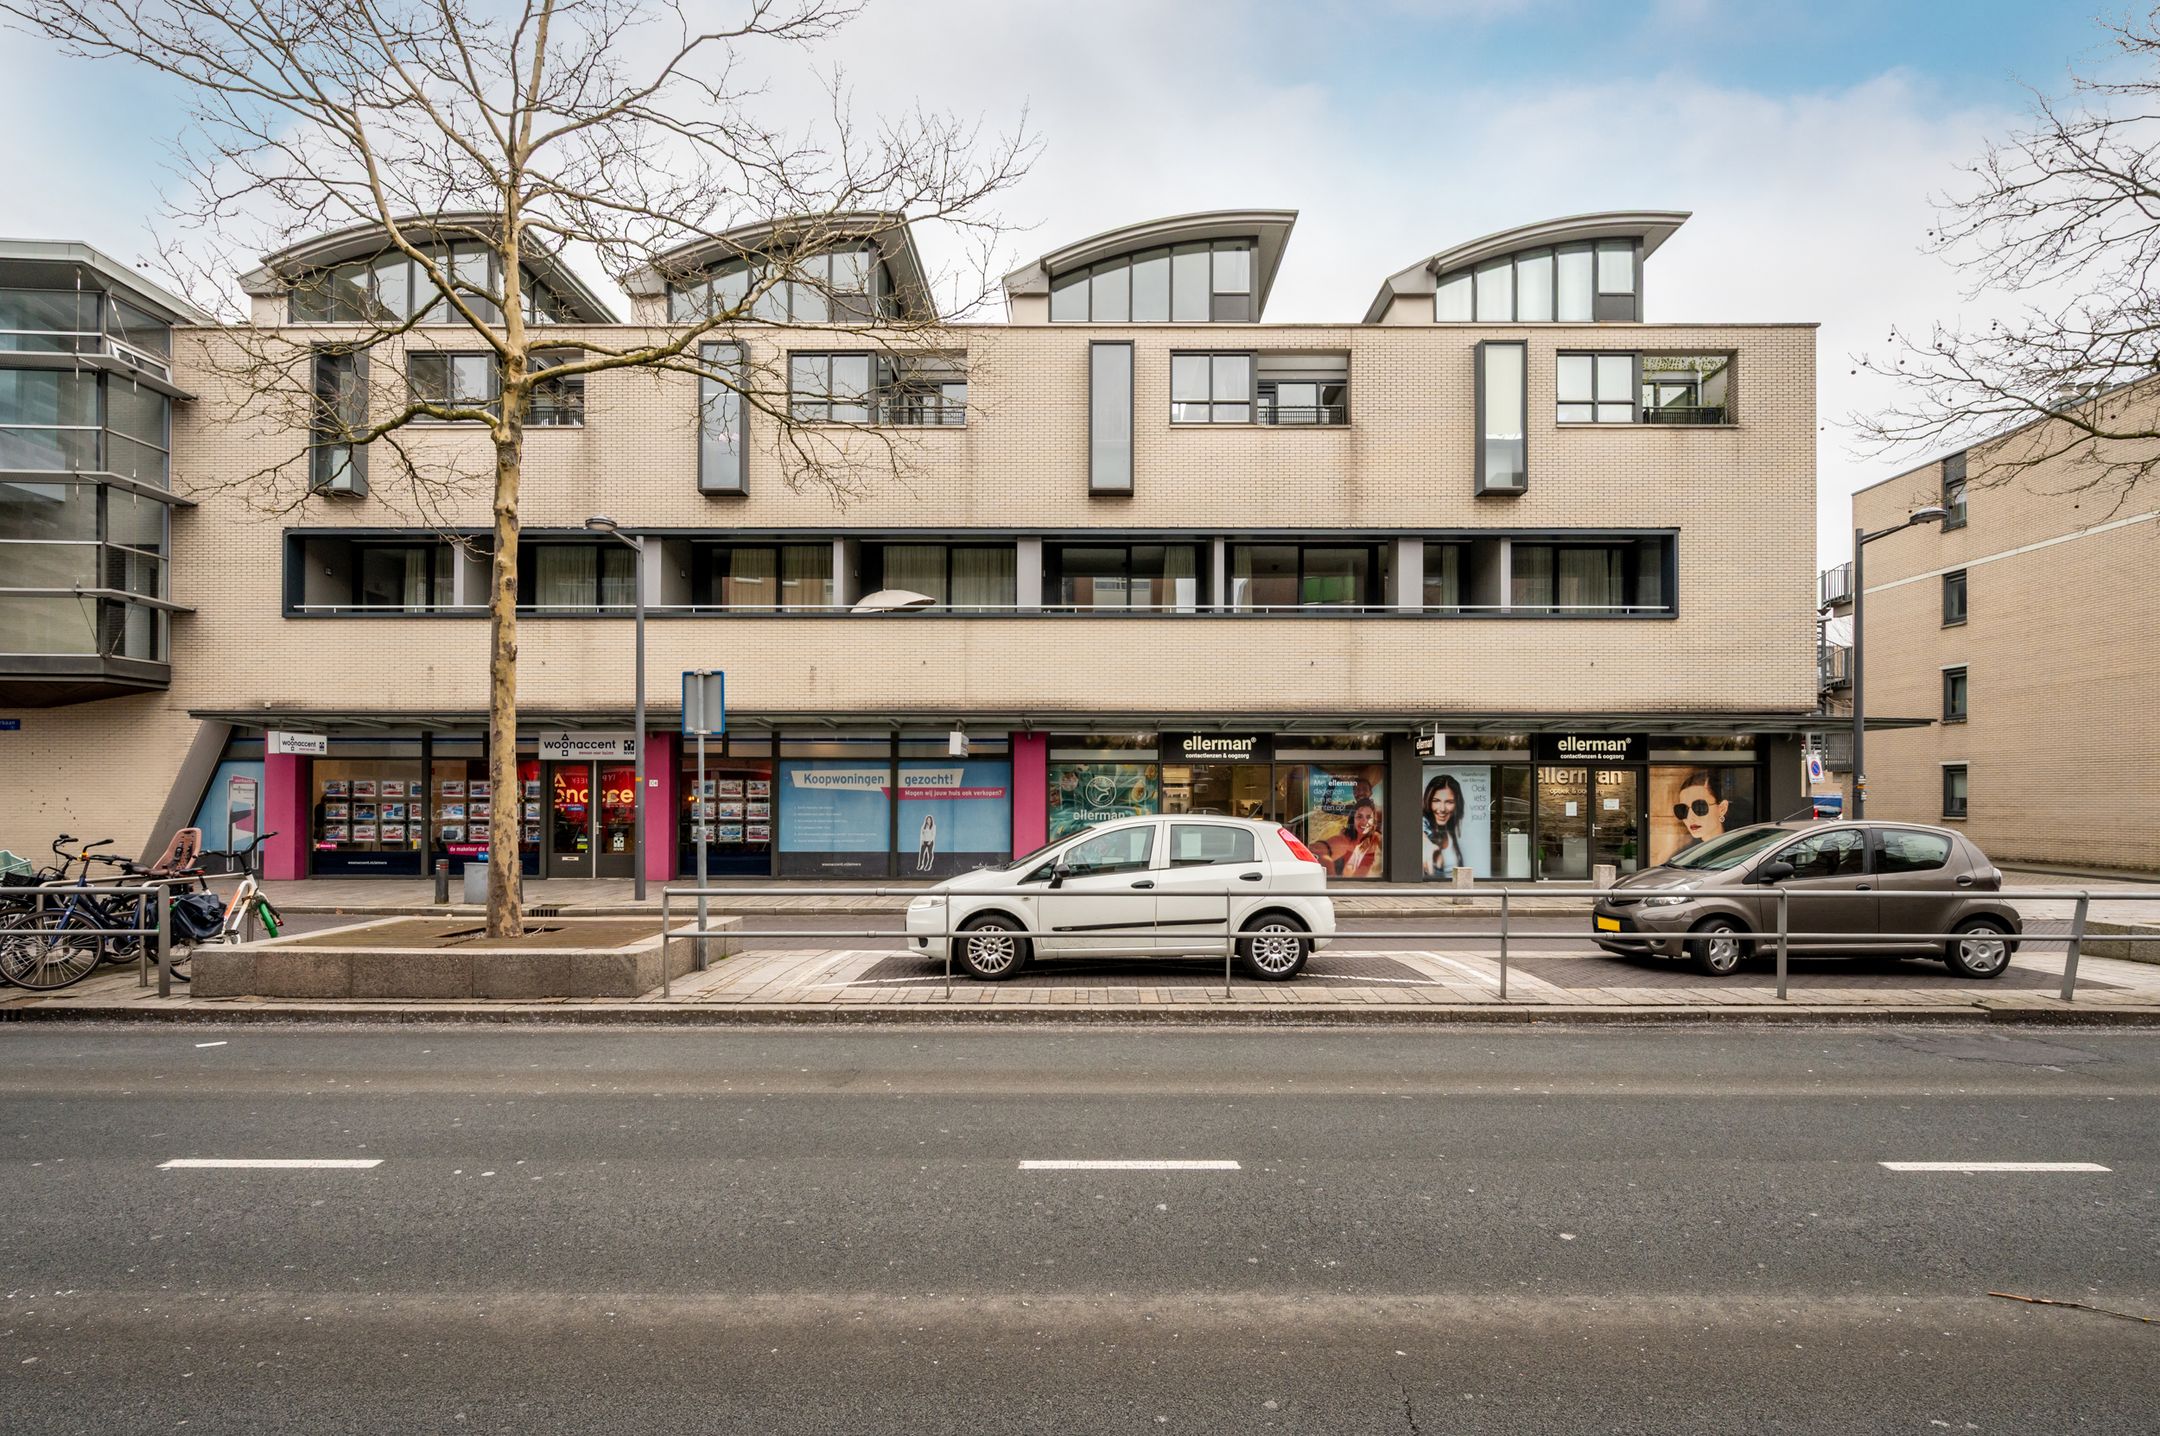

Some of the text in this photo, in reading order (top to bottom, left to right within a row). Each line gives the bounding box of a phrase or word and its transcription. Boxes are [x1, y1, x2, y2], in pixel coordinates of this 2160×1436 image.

[282, 740, 317, 748] woonaccent
[544, 740, 617, 749] woonaccent
[804, 773, 953, 787] Koopwoningen gezocht!
[1328, 779, 1358, 787] ellerman
[1472, 784, 1487, 792] Ook
[1474, 794, 1487, 802] iets
[1073, 809, 1125, 820] ellerman
